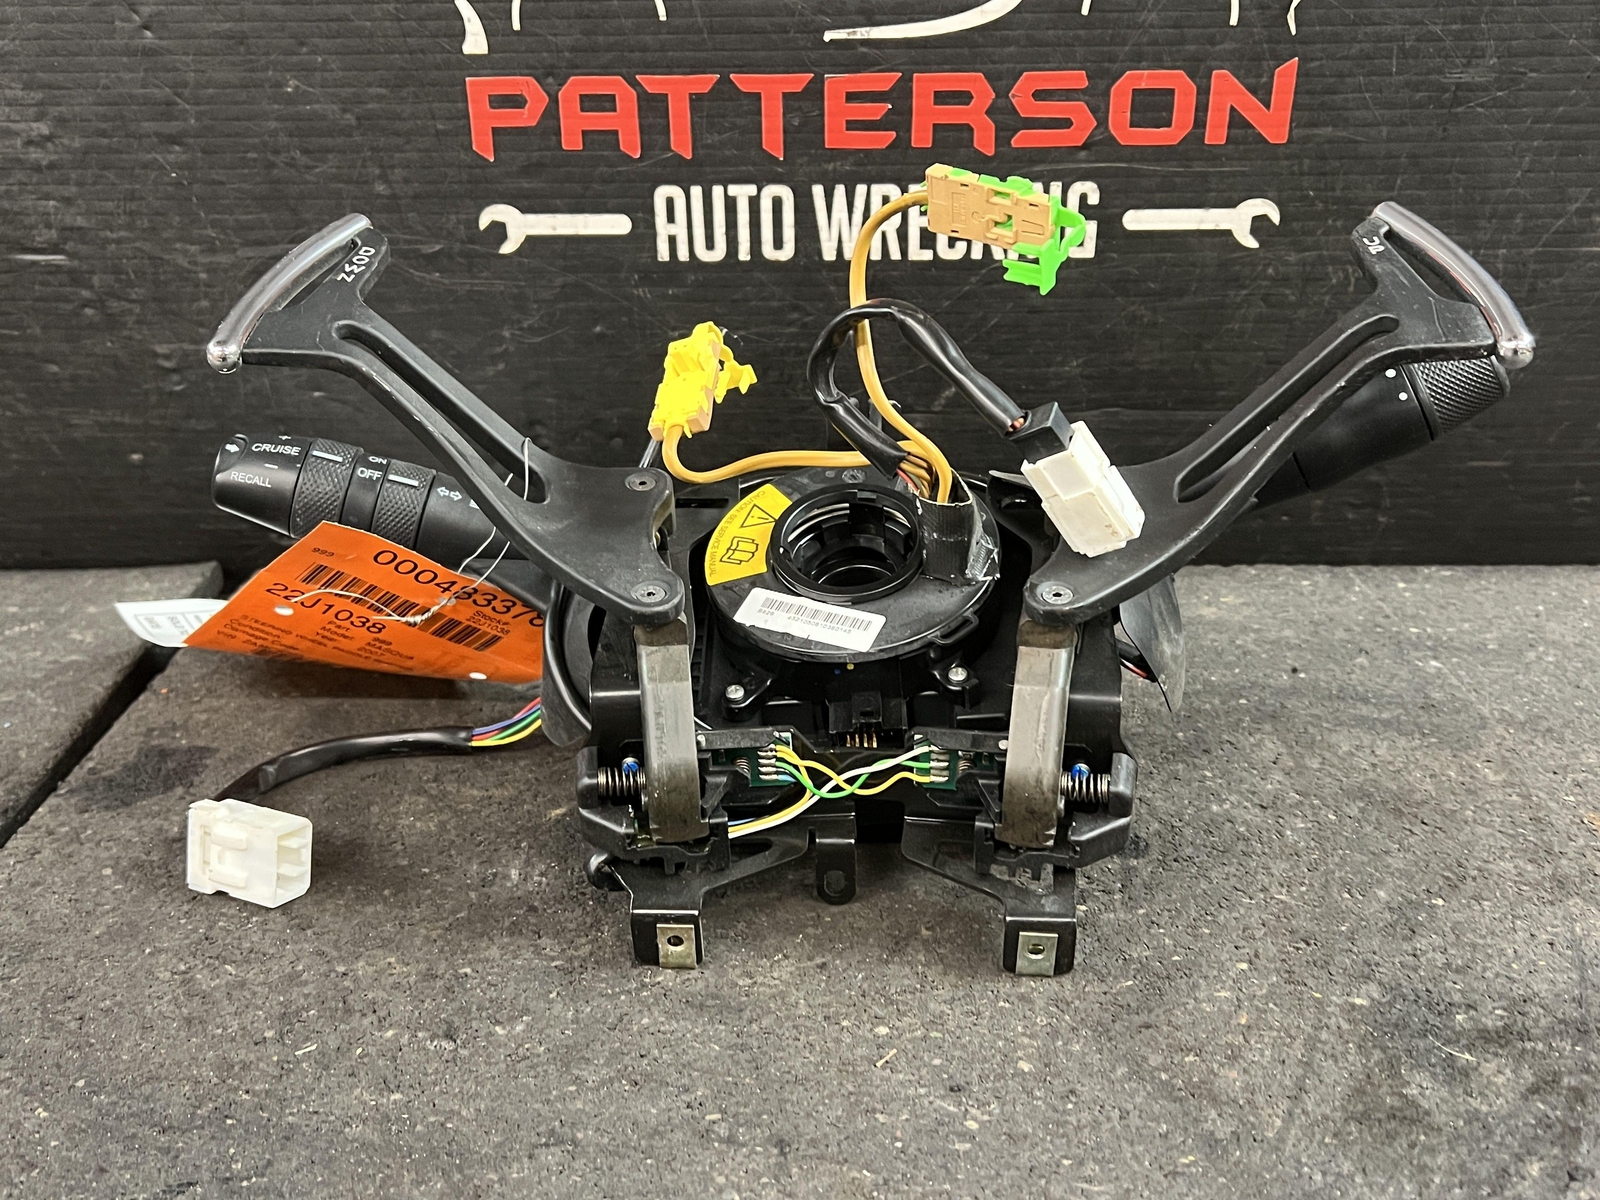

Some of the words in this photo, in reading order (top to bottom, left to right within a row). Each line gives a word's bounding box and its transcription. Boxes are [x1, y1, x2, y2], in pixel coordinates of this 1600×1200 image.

[466, 57, 1299, 162] PATTERSON
[654, 183, 797, 262] AUTO
[336, 245, 377, 284] DOWN
[251, 442, 302, 456] CRUISE
[368, 455, 388, 465] ON
[230, 471, 272, 488] RECALL
[356, 466, 384, 481] OFF
[311, 546, 335, 558] 999
[265, 582, 388, 635] 22J1038
